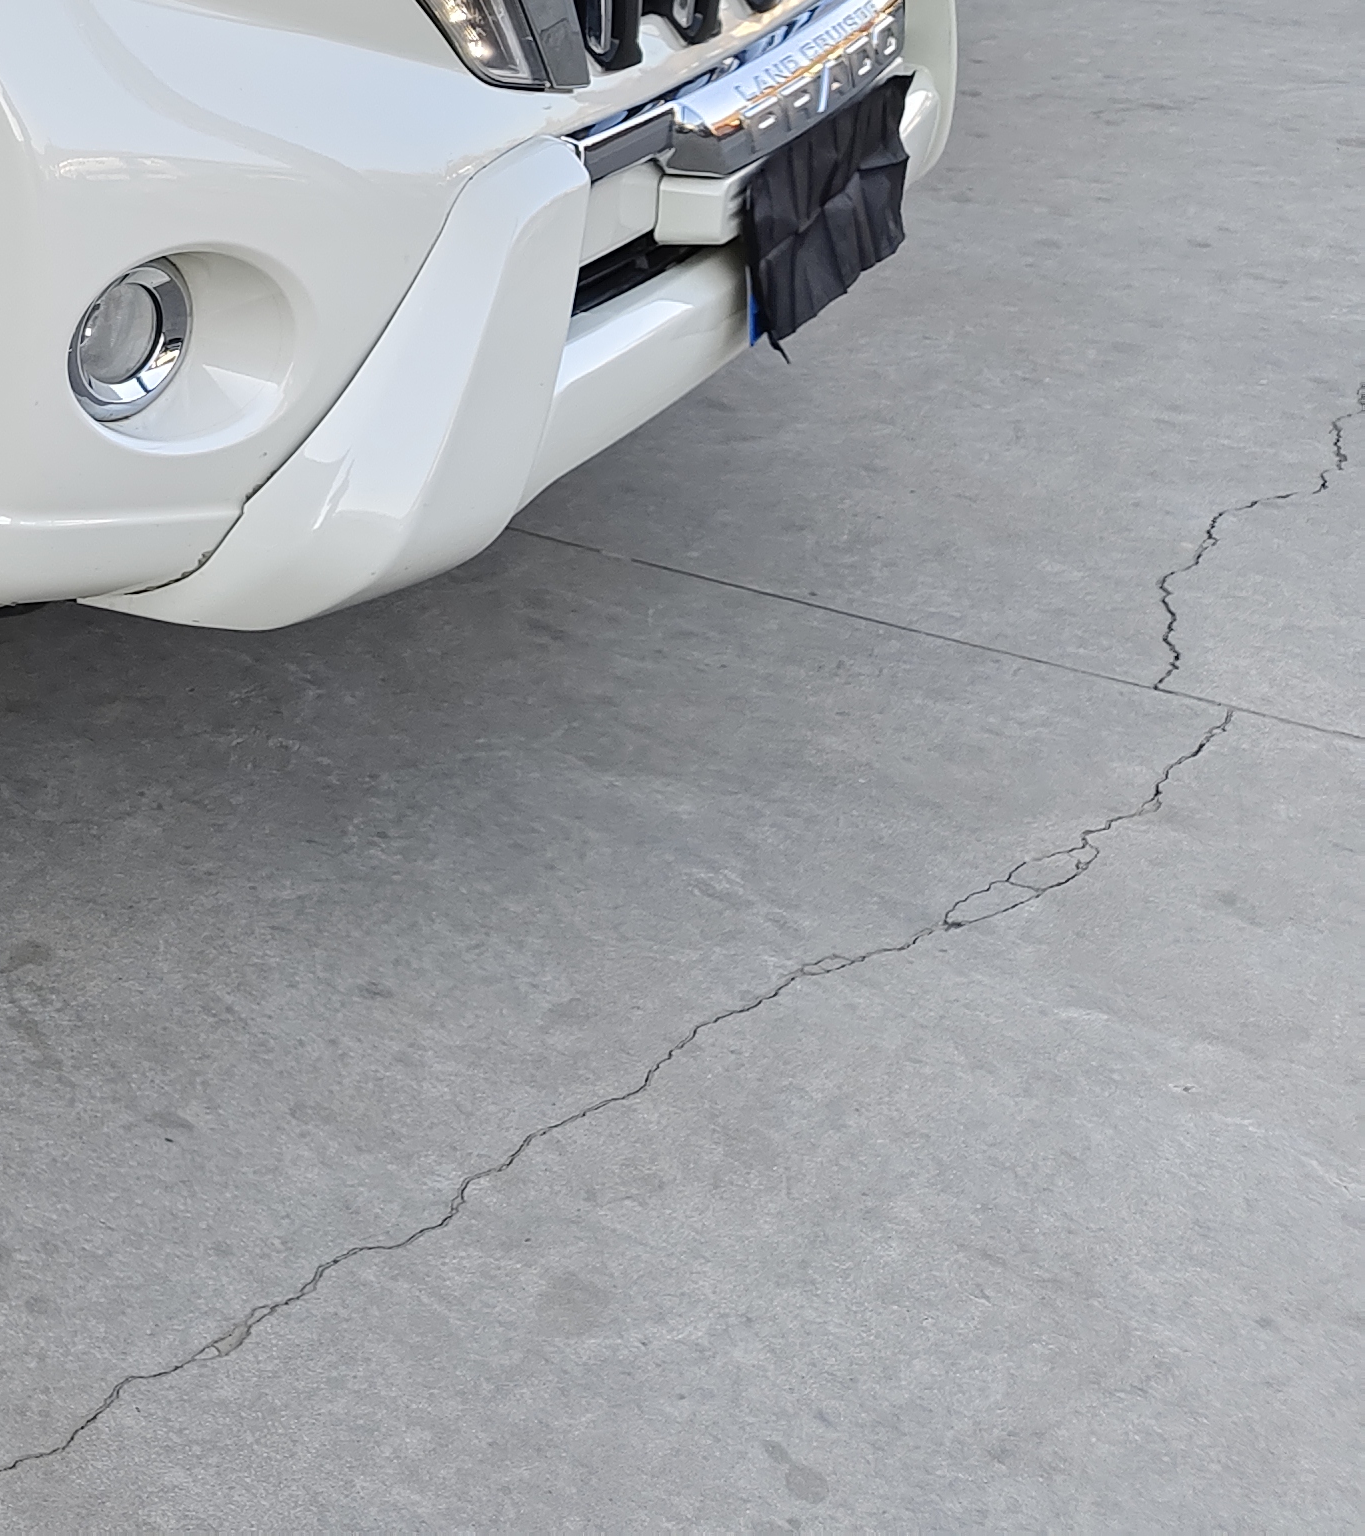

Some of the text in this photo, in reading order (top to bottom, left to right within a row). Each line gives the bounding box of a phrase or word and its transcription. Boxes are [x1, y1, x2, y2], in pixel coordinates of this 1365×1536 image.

[735, 0, 877, 101] LAND CRUISER
[743, 16, 898, 152] PRADO
